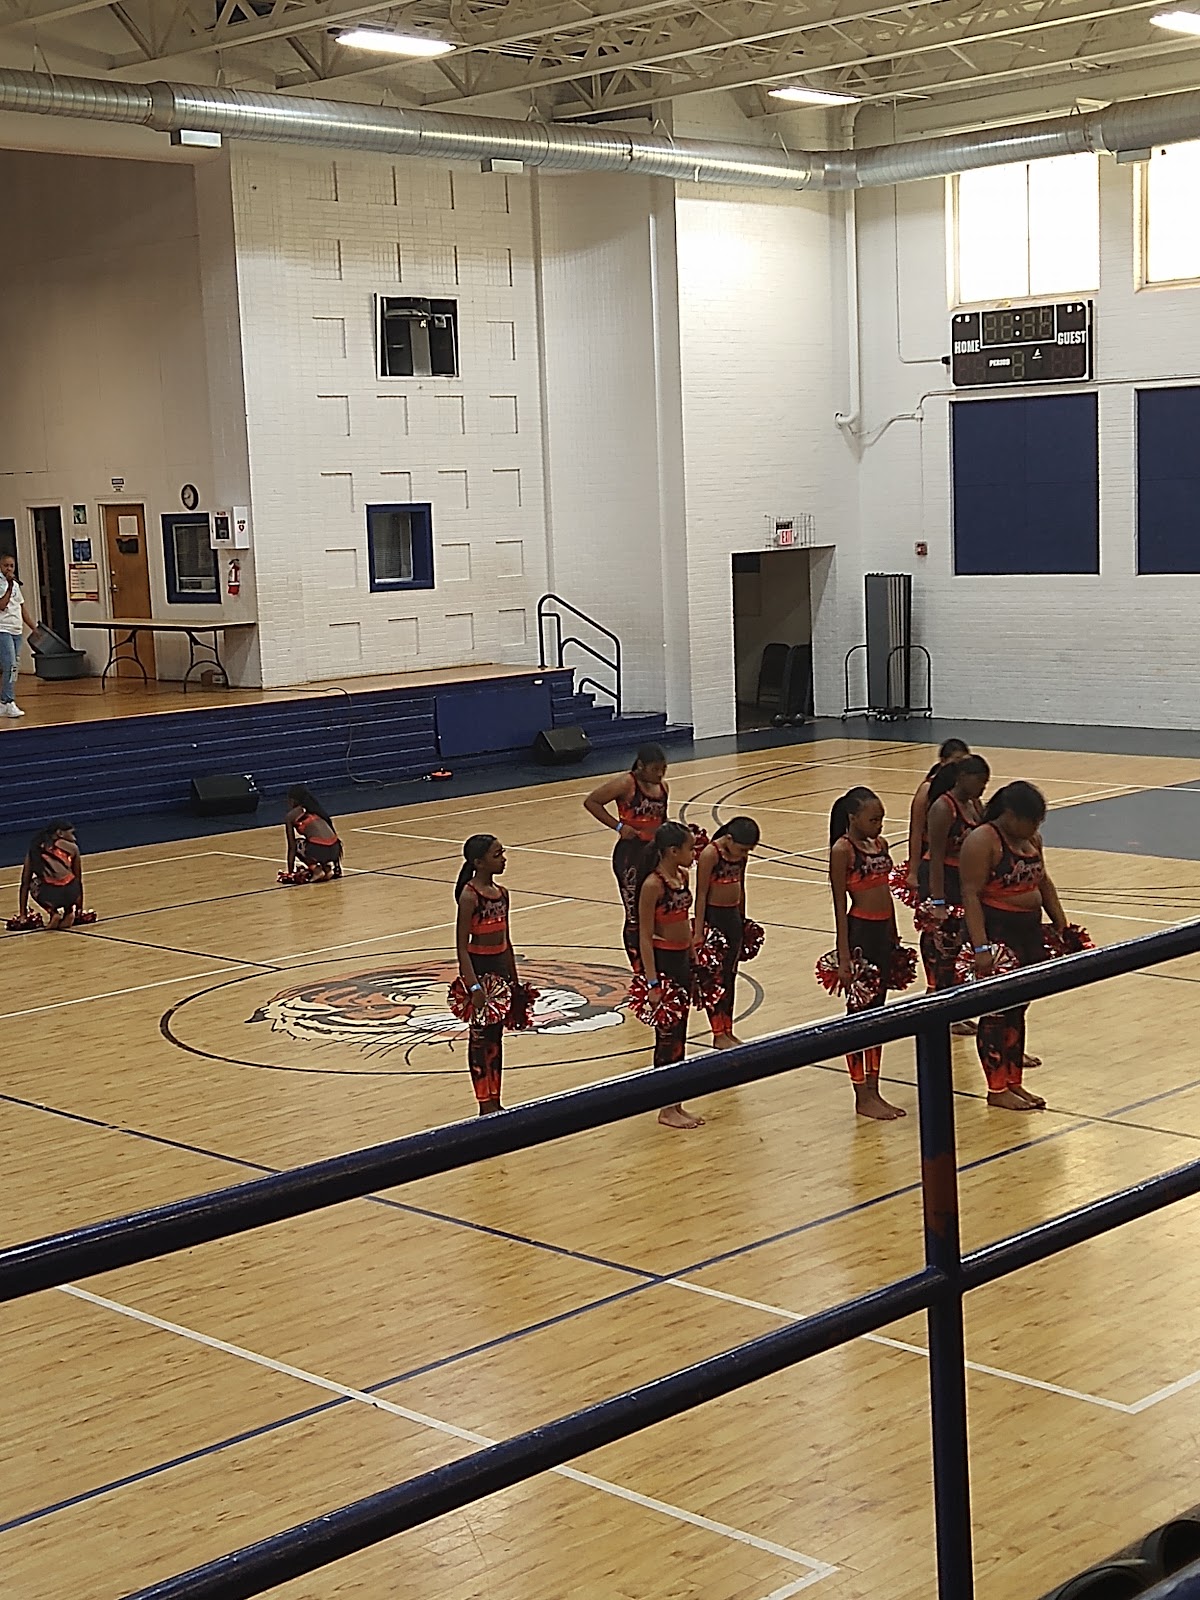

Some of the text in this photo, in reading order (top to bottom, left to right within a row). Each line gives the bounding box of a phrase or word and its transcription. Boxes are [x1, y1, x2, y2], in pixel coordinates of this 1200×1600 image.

[1057, 331, 1086, 345] GUEST
[954, 339, 981, 355] HOME
[989, 358, 1011, 367] PERIOD
[782, 530, 792, 543] EXIT
